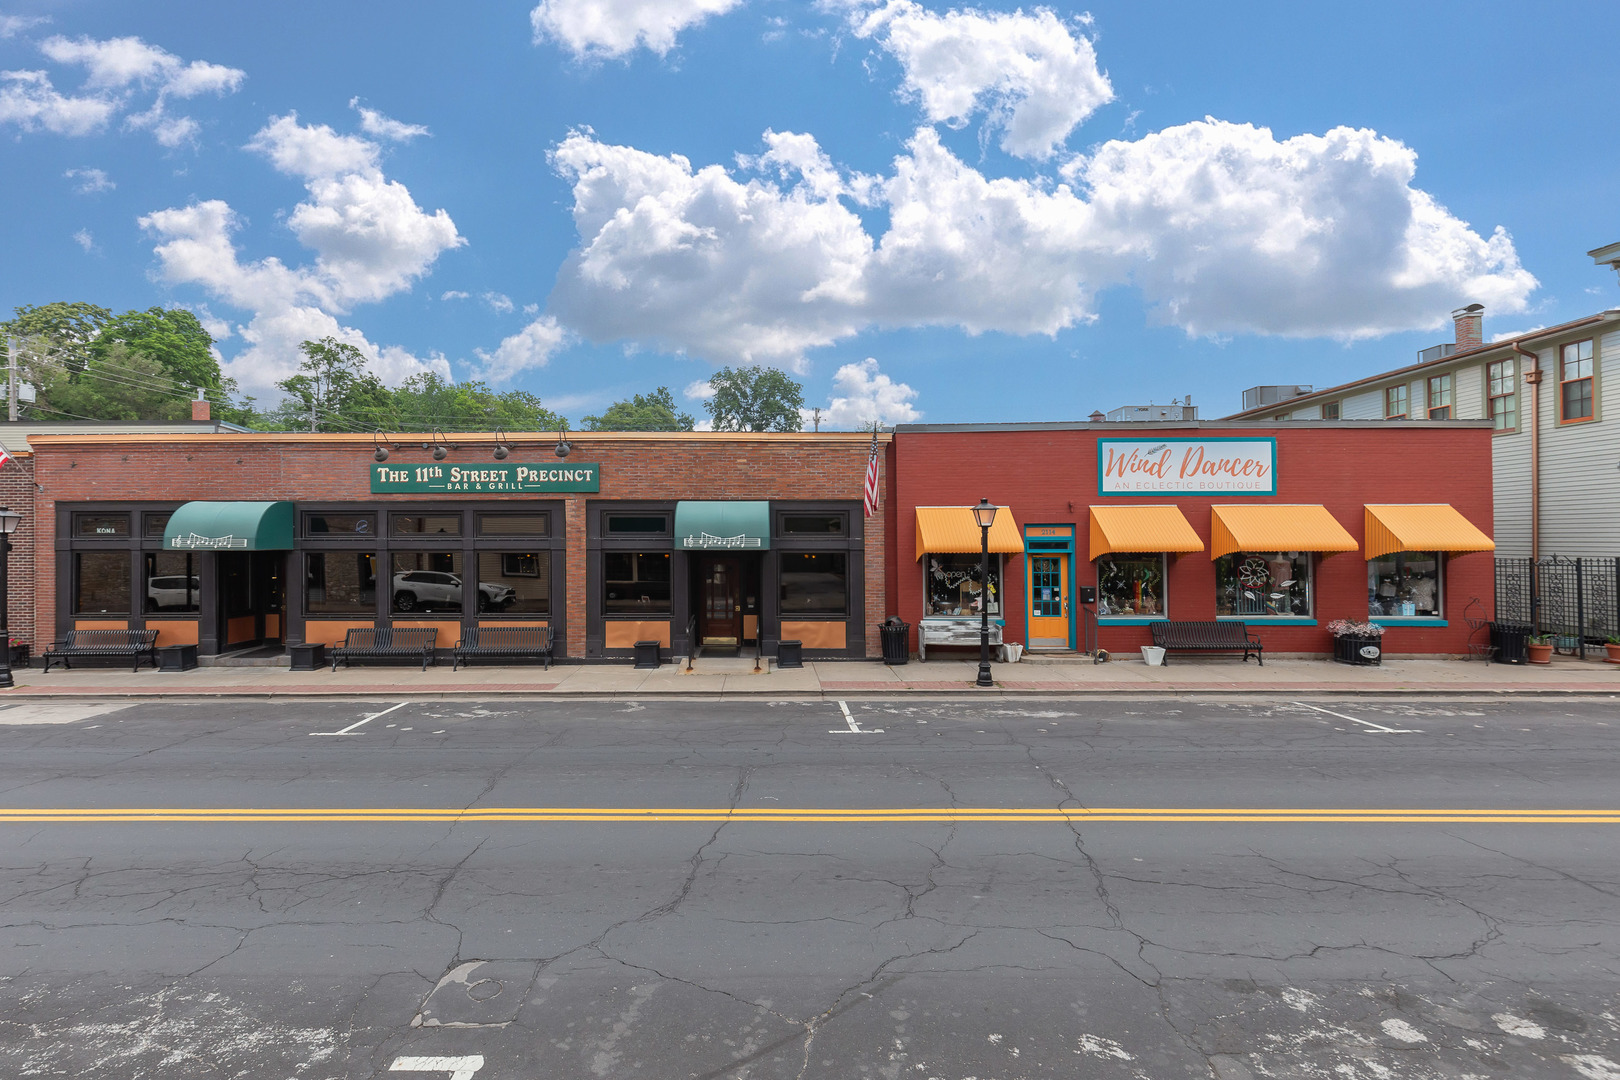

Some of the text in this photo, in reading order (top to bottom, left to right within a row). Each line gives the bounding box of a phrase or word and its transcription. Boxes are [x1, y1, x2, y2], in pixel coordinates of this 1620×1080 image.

[415, 466, 443, 482] 11th
[1105, 445, 1270, 479] Wind Dancer
